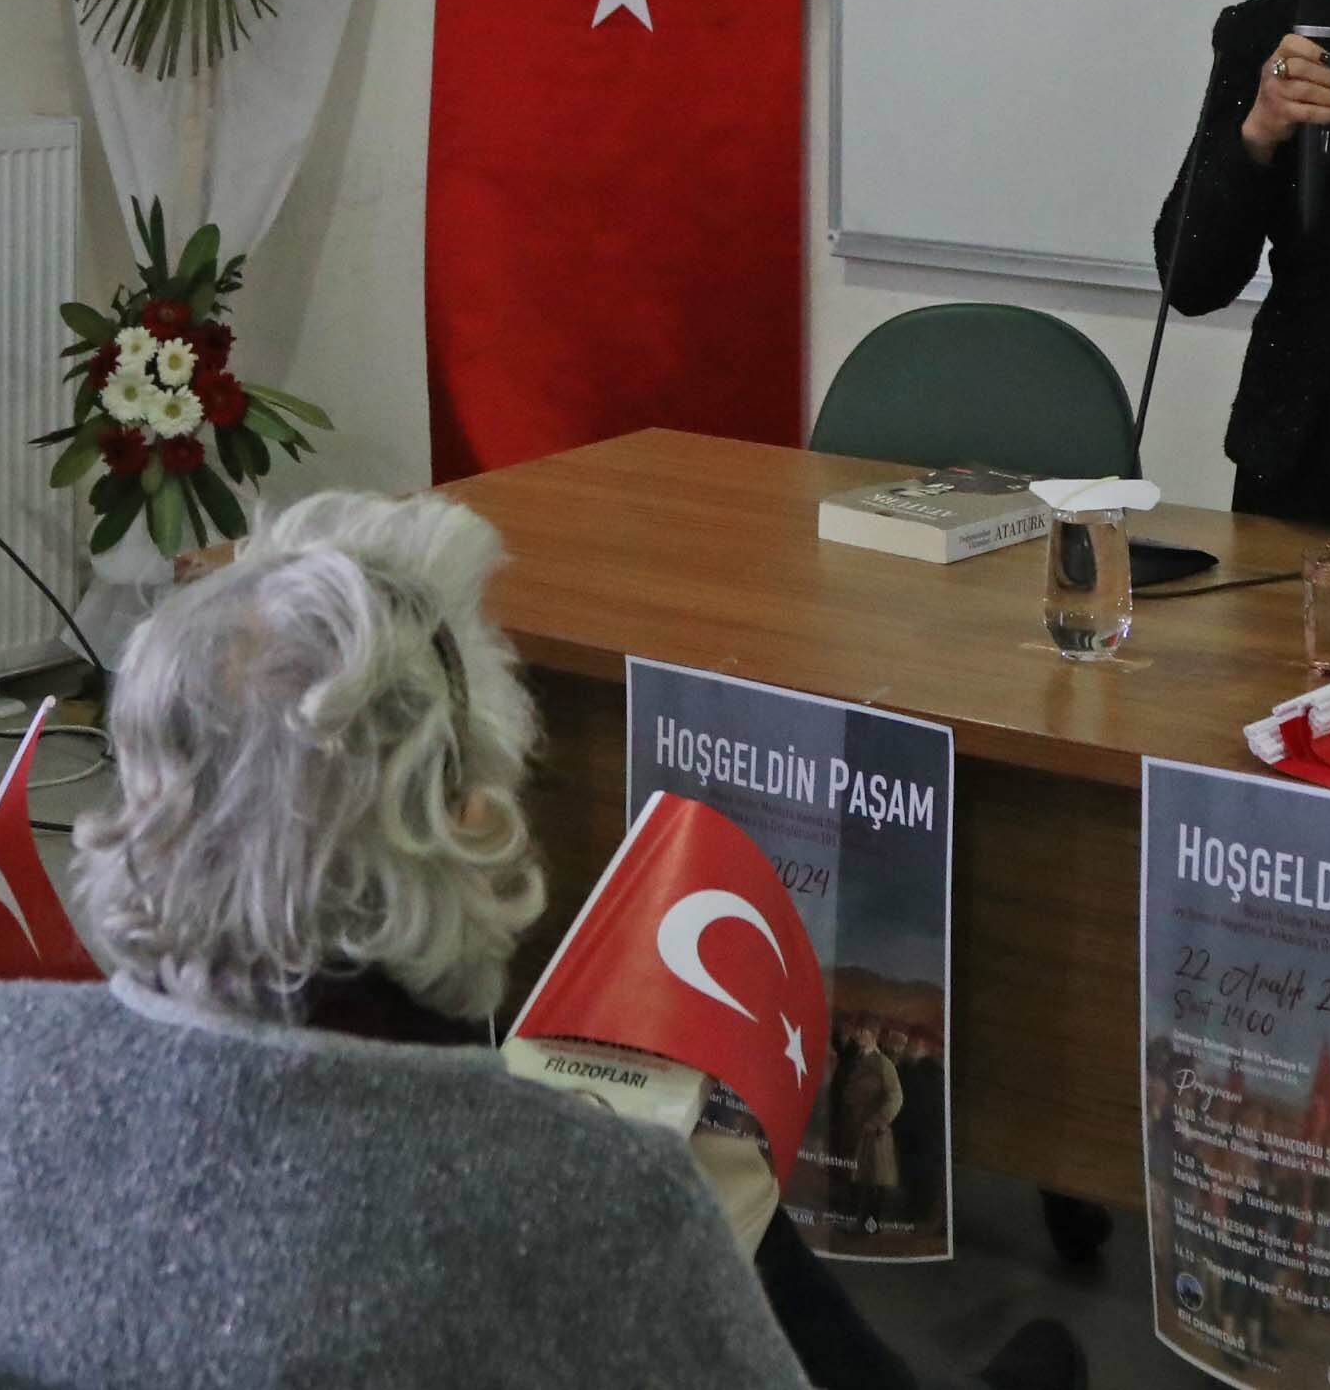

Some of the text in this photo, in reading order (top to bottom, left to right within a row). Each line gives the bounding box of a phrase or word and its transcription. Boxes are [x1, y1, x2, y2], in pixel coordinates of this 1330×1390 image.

[656, 714, 816, 810] HOŞGELDİN
[829, 758, 934, 831] PAŞAM
[1173, 945, 1211, 982] 22
[544, 1056, 649, 1090] FİLOZOFLARI
[1173, 1068, 1243, 1111] Program
